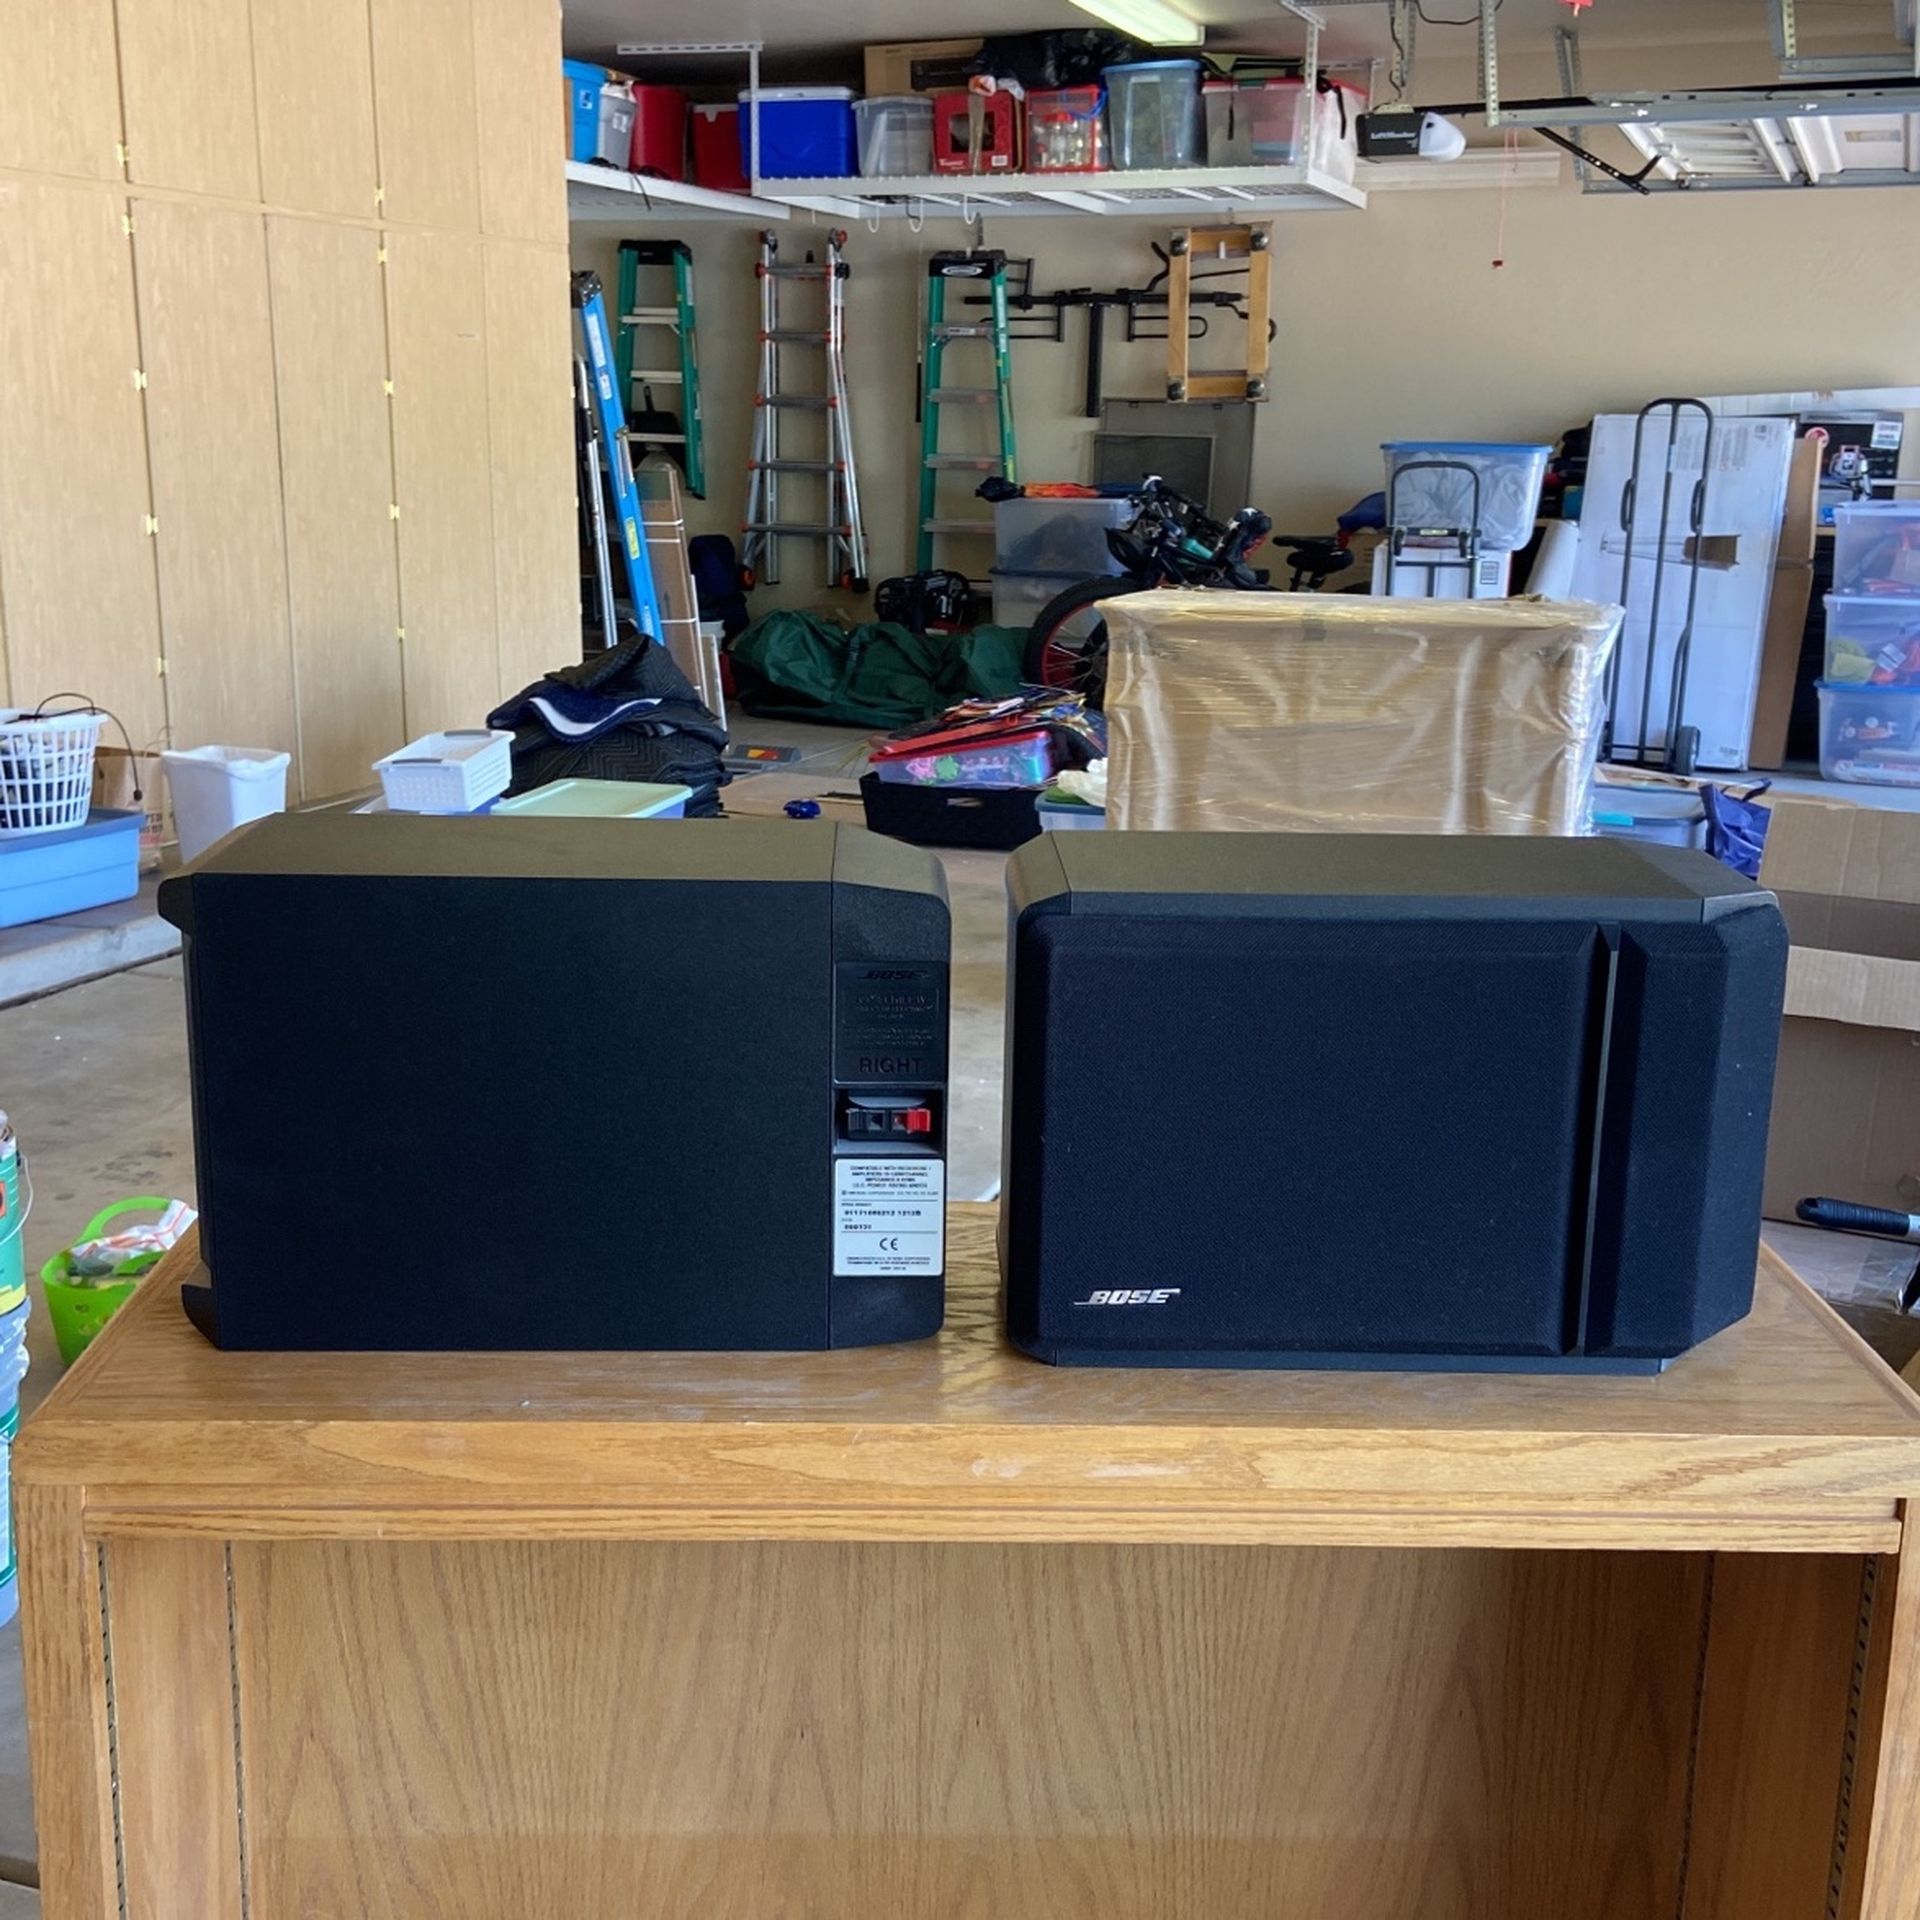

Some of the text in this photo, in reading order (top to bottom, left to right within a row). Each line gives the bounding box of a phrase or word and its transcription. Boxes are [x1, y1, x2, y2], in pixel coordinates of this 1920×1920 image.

[859, 1057, 924, 1073] RIGHT
[879, 1237, 899, 1251] CE
[1073, 1288, 1181, 1305] BOSE
